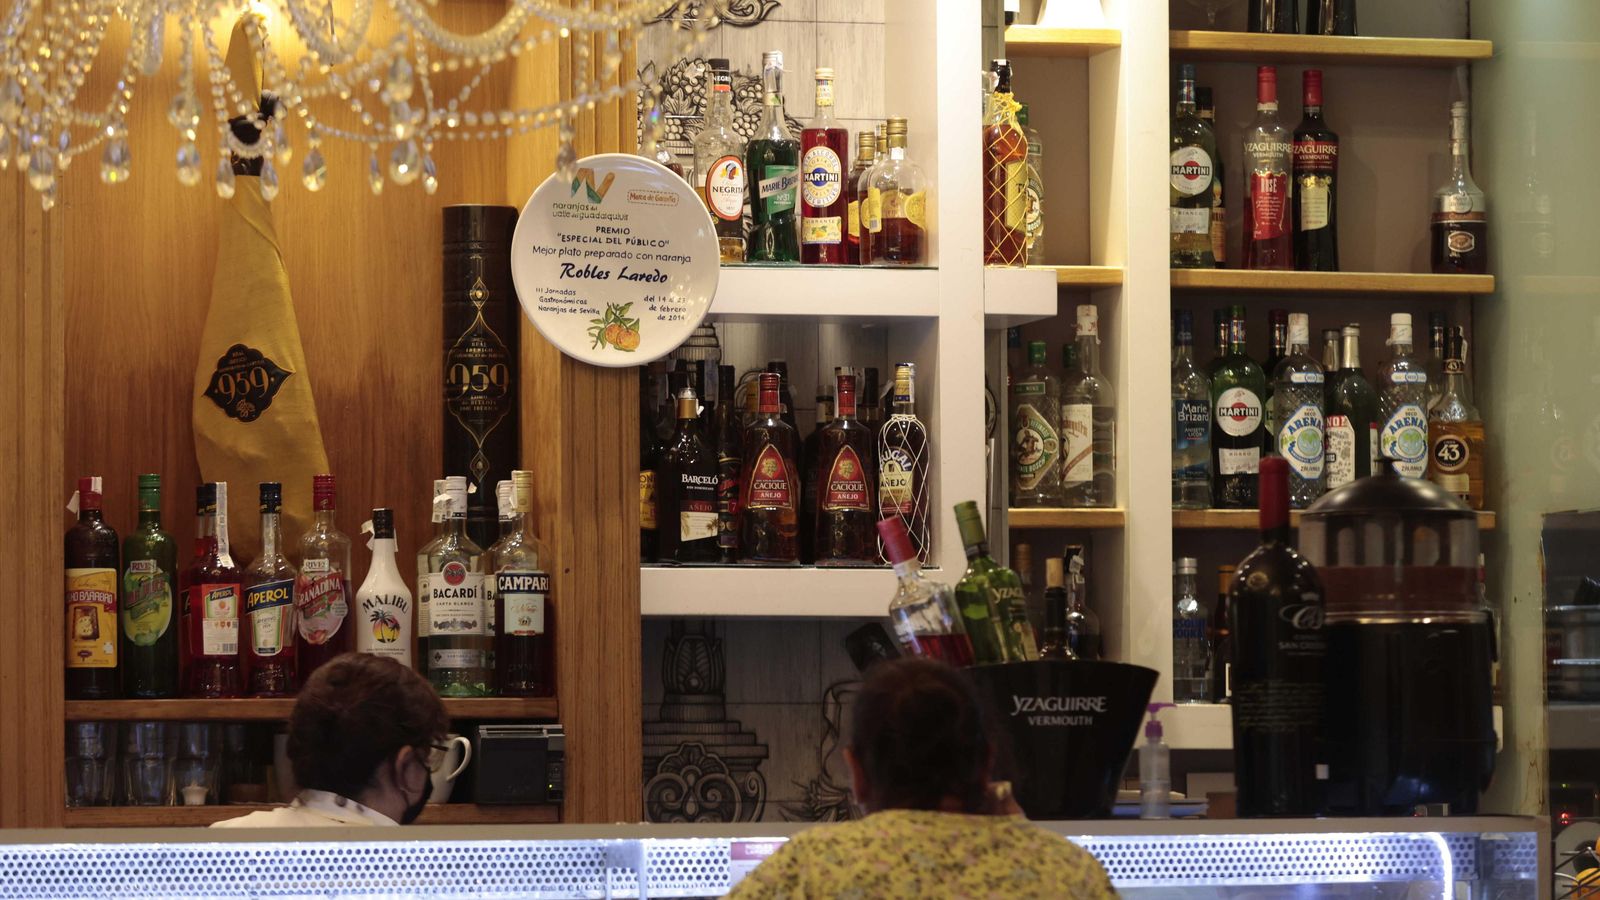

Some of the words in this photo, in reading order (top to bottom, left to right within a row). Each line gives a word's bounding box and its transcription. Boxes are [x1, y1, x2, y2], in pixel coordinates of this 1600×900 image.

[1171, 166, 1209, 175] MARTINI
[804, 173, 838, 182] MARTINI
[553, 202, 589, 212] naranjas
[596, 226, 631, 235] PREMIO
[606, 237, 622, 245] DEL
[532, 245, 557, 256] Mejor
[558, 246, 582, 258] plato
[584, 249, 633, 261] preparado
[636, 252, 653, 261] con
[655, 253, 692, 265] naranja
[559, 262, 610, 280] Robles
[617, 266, 668, 283] Laredo
[544, 287, 577, 296] Jornadas
[538, 296, 588, 305] Gastronómicas
[538, 305, 567, 315] Naranjas
[579, 307, 600, 315] Sevilla
[648, 304, 657, 312] de
[659, 304, 687, 313] febrero
[657, 313, 666, 321] de
[218, 366, 269, 404] 959
[450, 363, 510, 400] 959
[1181, 403, 1208, 413] Marie
[1220, 407, 1258, 416] MARTINI
[1178, 411, 1209, 422] Brizard
[1438, 444, 1460, 461] 43
[681, 474, 719, 485] BARCELÓ
[753, 482, 788, 491] CACIQUE
[831, 483, 865, 492] CACIQUE
[760, 491, 782, 499] AÑEJO
[837, 492, 859, 500] AÑEJO
[688, 503, 713, 511] AÑEJO
[731, 502, 737, 511] 7
[498, 576, 549, 591] CAMPARI
[211, 589, 233, 600] APEROL
[433, 585, 478, 599] BACARDÍ
[247, 587, 289, 609] APEROL
[362, 594, 409, 615] MALIBU
[1010, 694, 1108, 716] YZAGUIRRE
[1028, 716, 1094, 726] VERMOUTH
